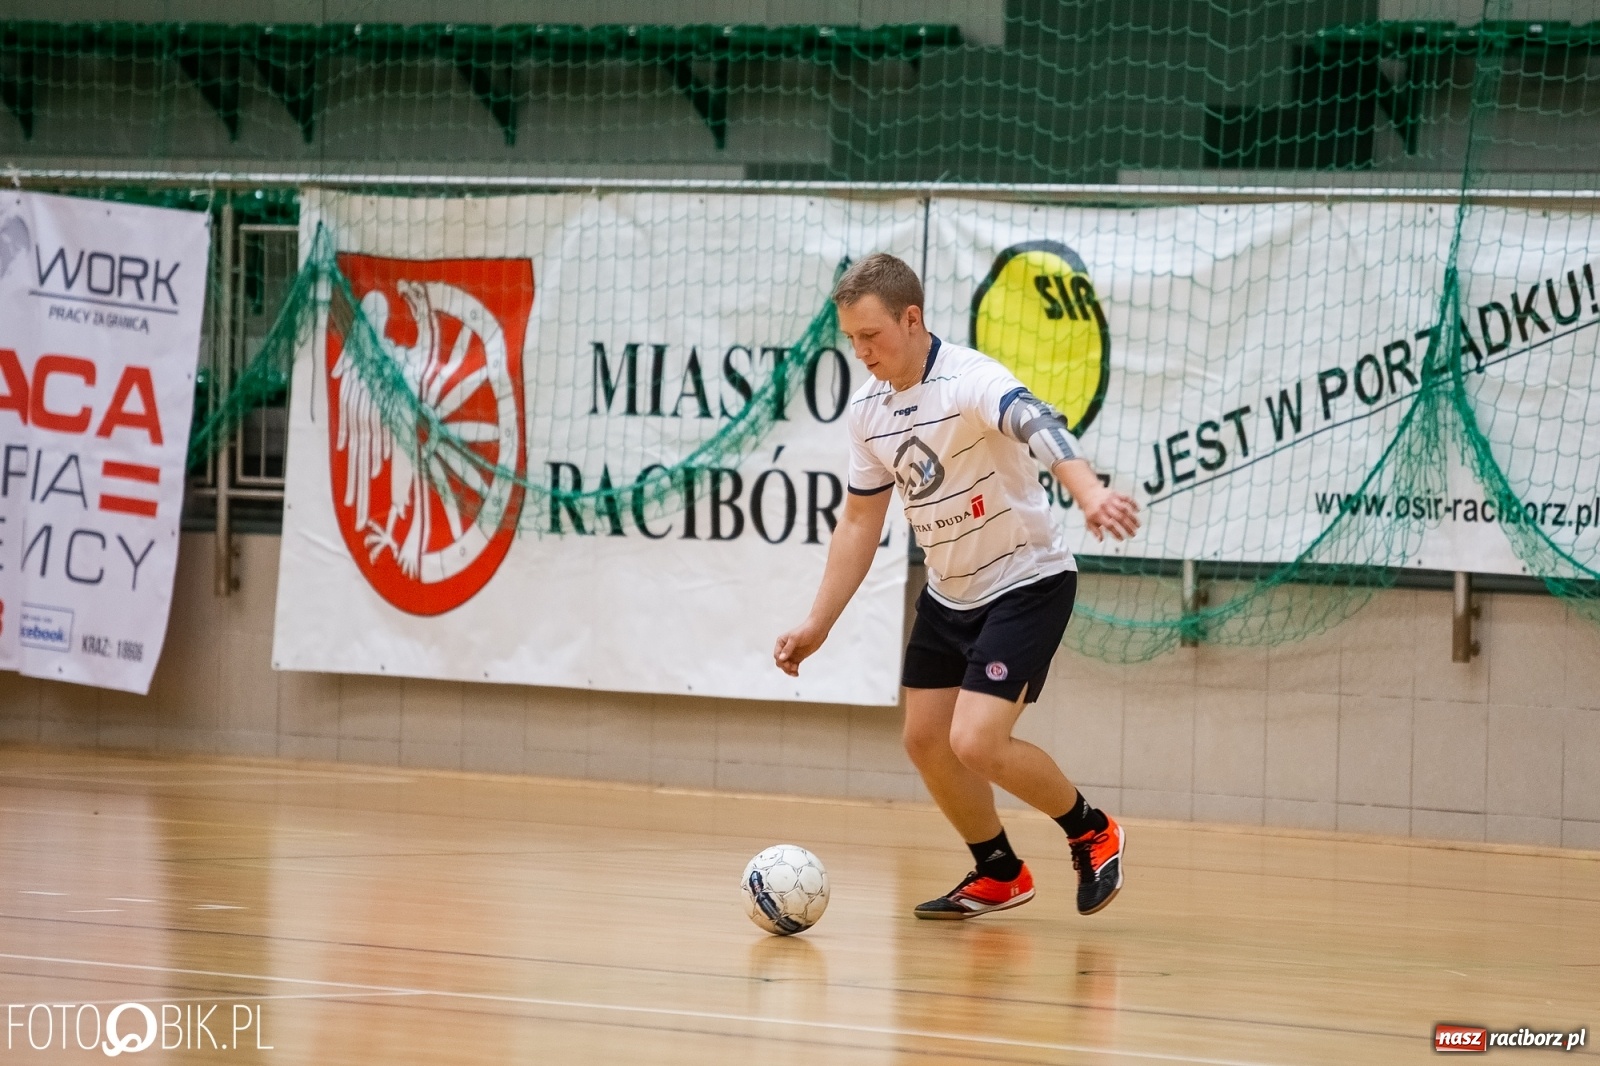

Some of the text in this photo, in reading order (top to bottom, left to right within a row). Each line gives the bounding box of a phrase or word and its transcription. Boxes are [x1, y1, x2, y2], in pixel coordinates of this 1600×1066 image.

[35, 244, 181, 305] WORK
[589, 341, 851, 424] MIASTO
[1143, 404, 1252, 496] JEST
[1266, 379, 1302, 443] W
[545, 445, 890, 548] RACIBÓR
[935, 510, 972, 529] DUDA
